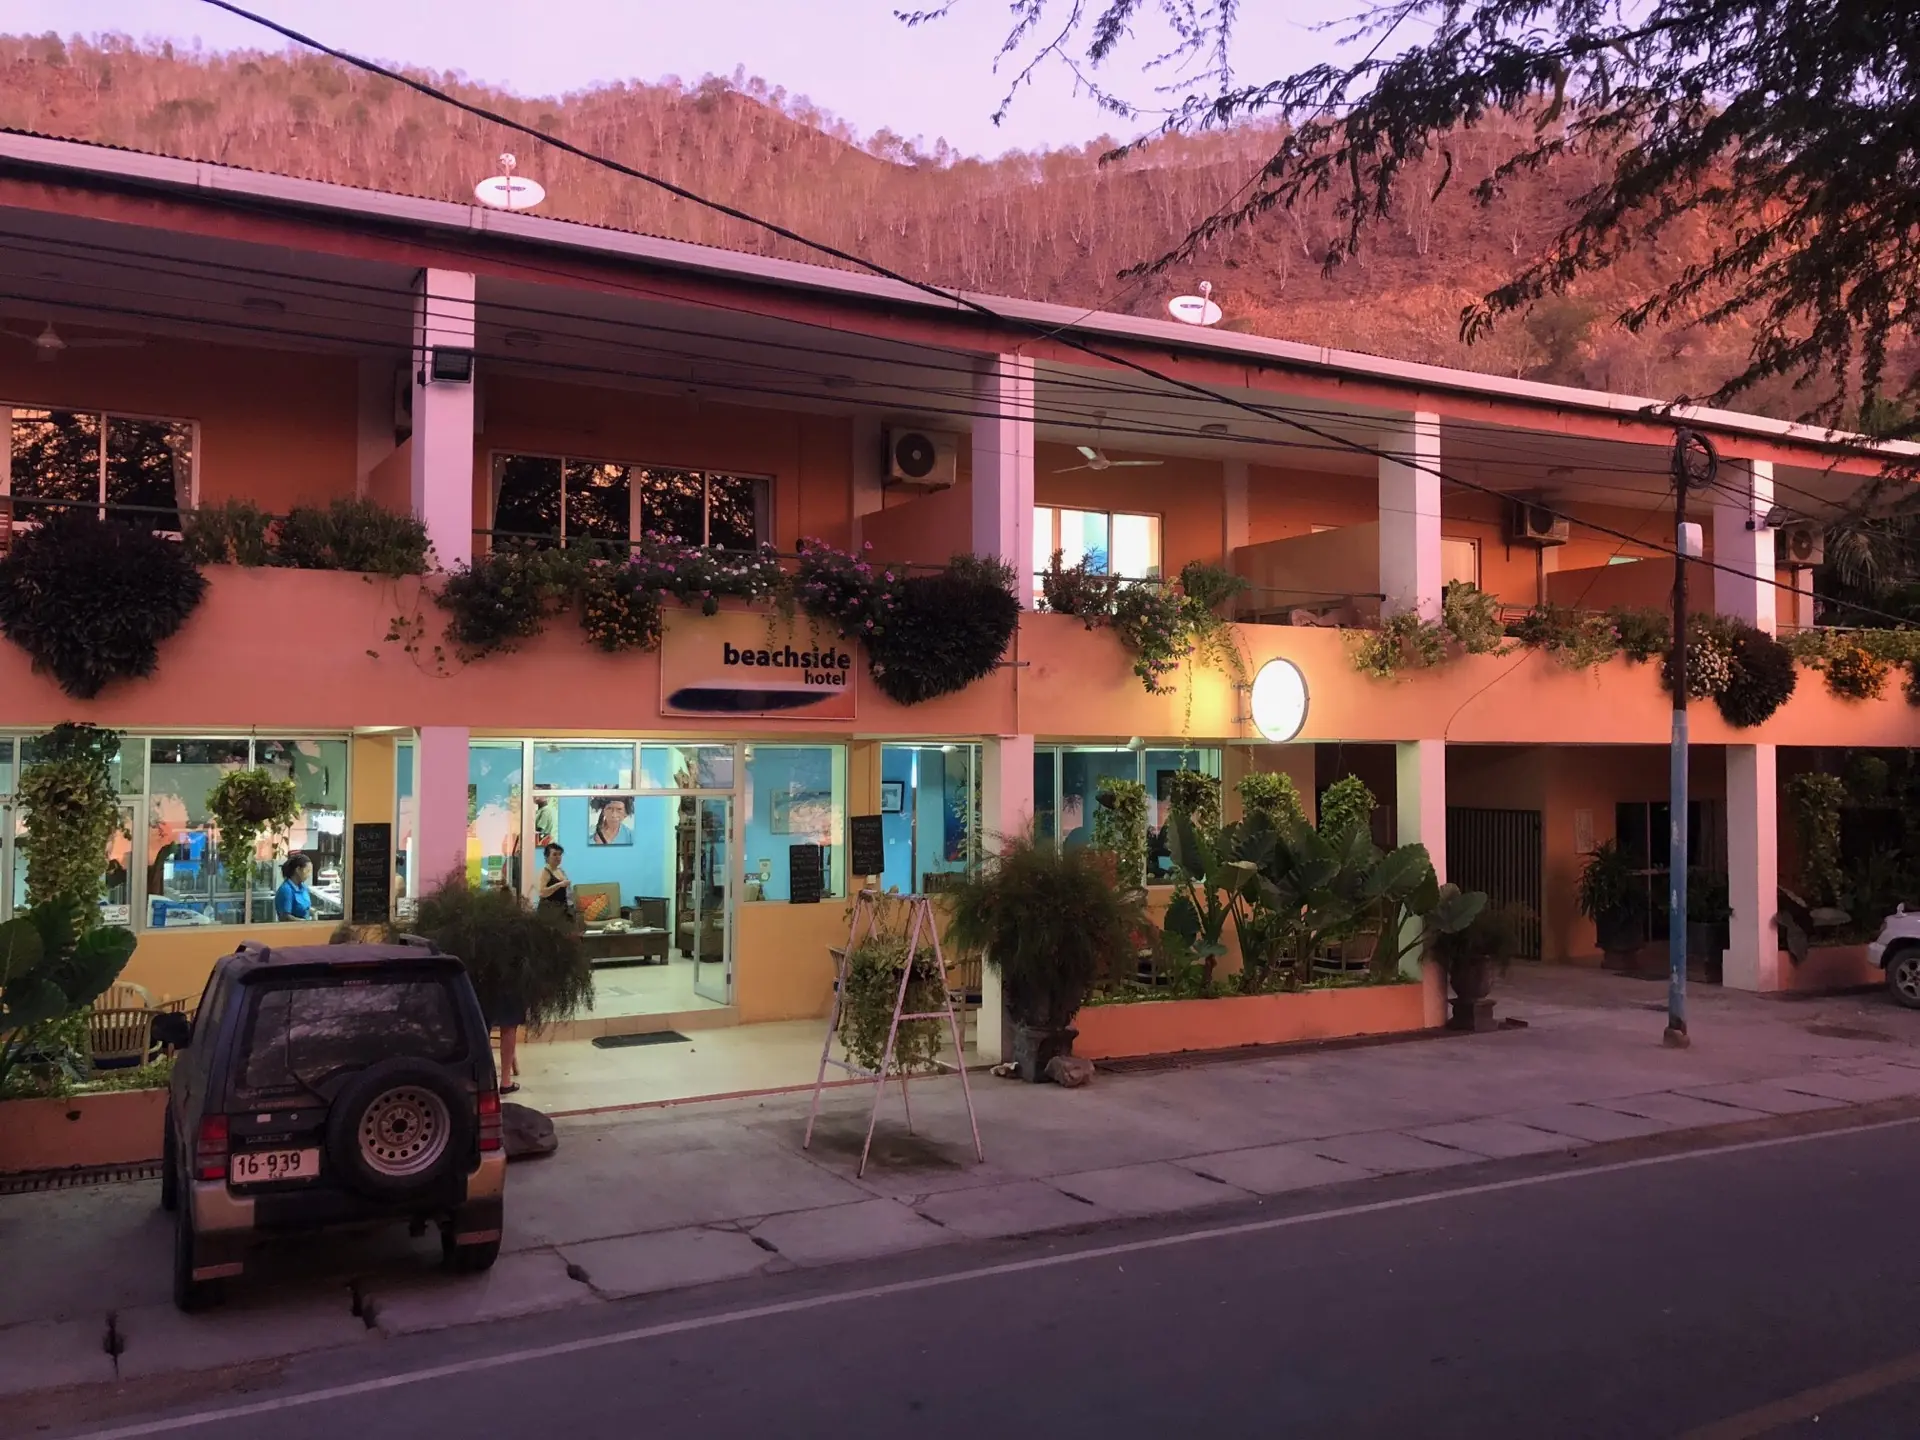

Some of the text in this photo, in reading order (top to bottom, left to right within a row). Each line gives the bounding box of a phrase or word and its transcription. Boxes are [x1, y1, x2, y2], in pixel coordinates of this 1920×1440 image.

[724, 642, 850, 668] beachside
[804, 669, 846, 685] hotel
[238, 1153, 301, 1176] 16-939
